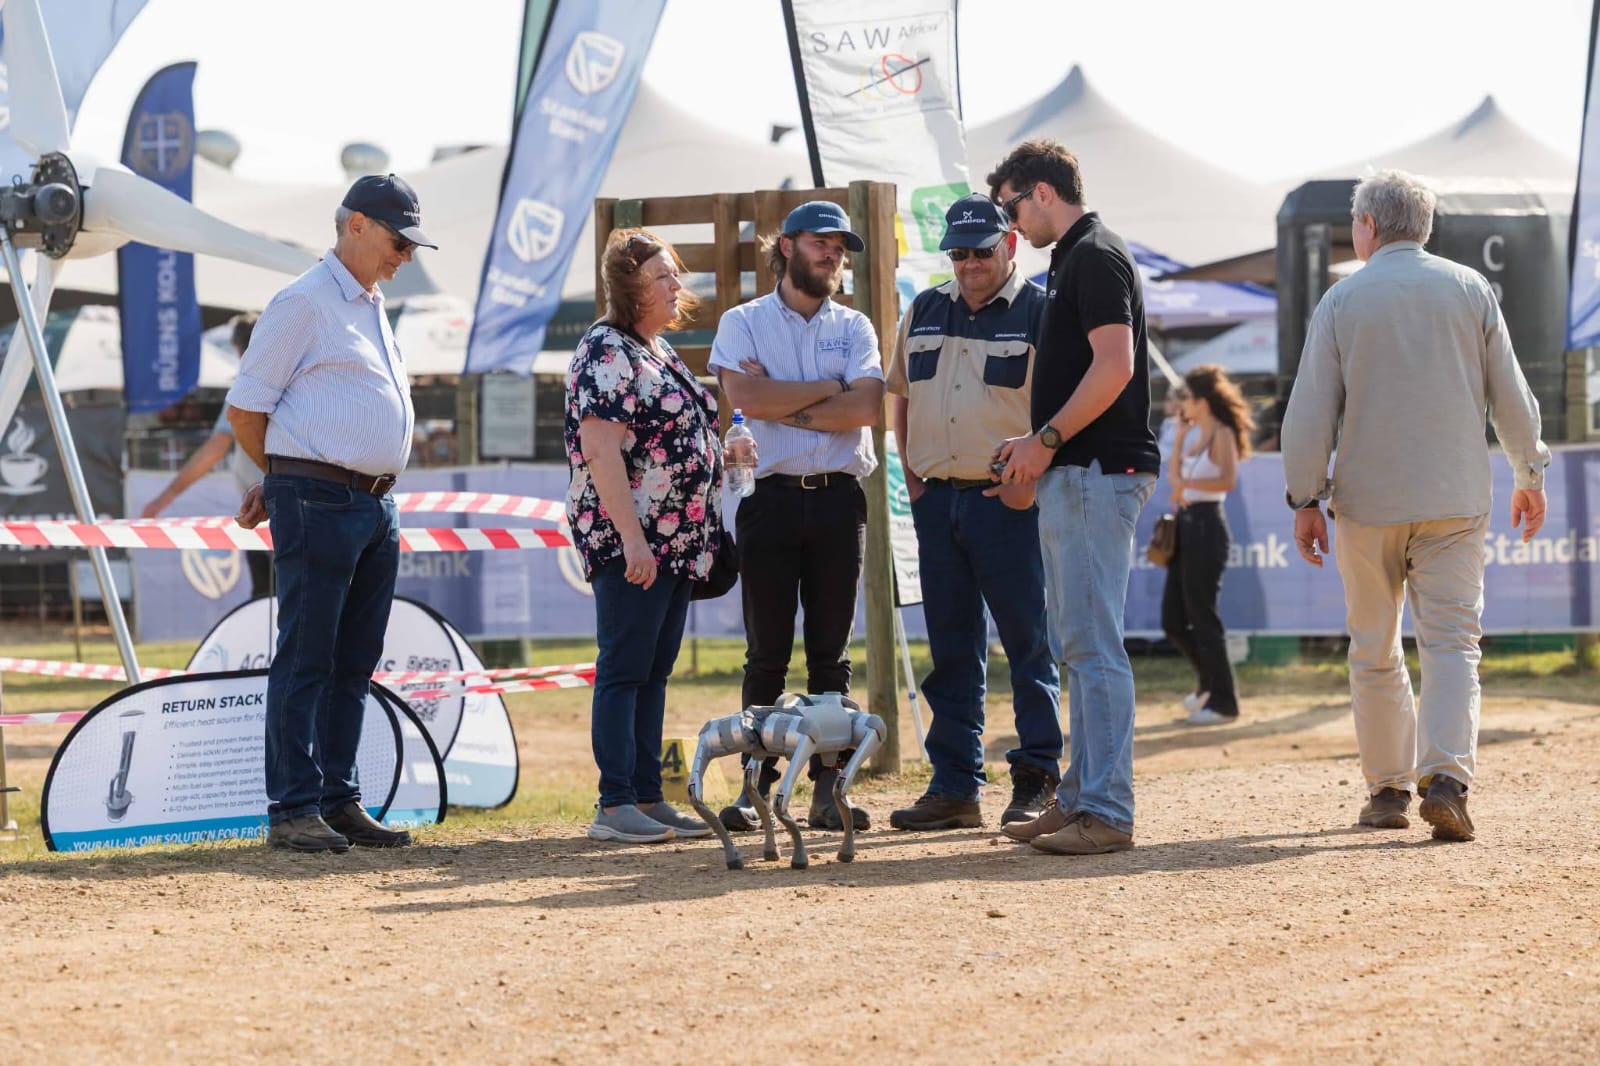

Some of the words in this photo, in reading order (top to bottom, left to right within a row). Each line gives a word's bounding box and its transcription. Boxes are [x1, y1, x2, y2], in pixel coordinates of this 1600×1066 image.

[157, 249, 177, 303] KOL
[1227, 532, 1289, 568] ank
[1483, 529, 1600, 565] Standa
[399, 549, 470, 577] Bank
[161, 698, 216, 714] RETURN
[219, 693, 264, 708] STACK
[662, 742, 682, 773] 4
[165, 829, 216, 844] SOLUTION
[217, 828, 239, 839] FOR
